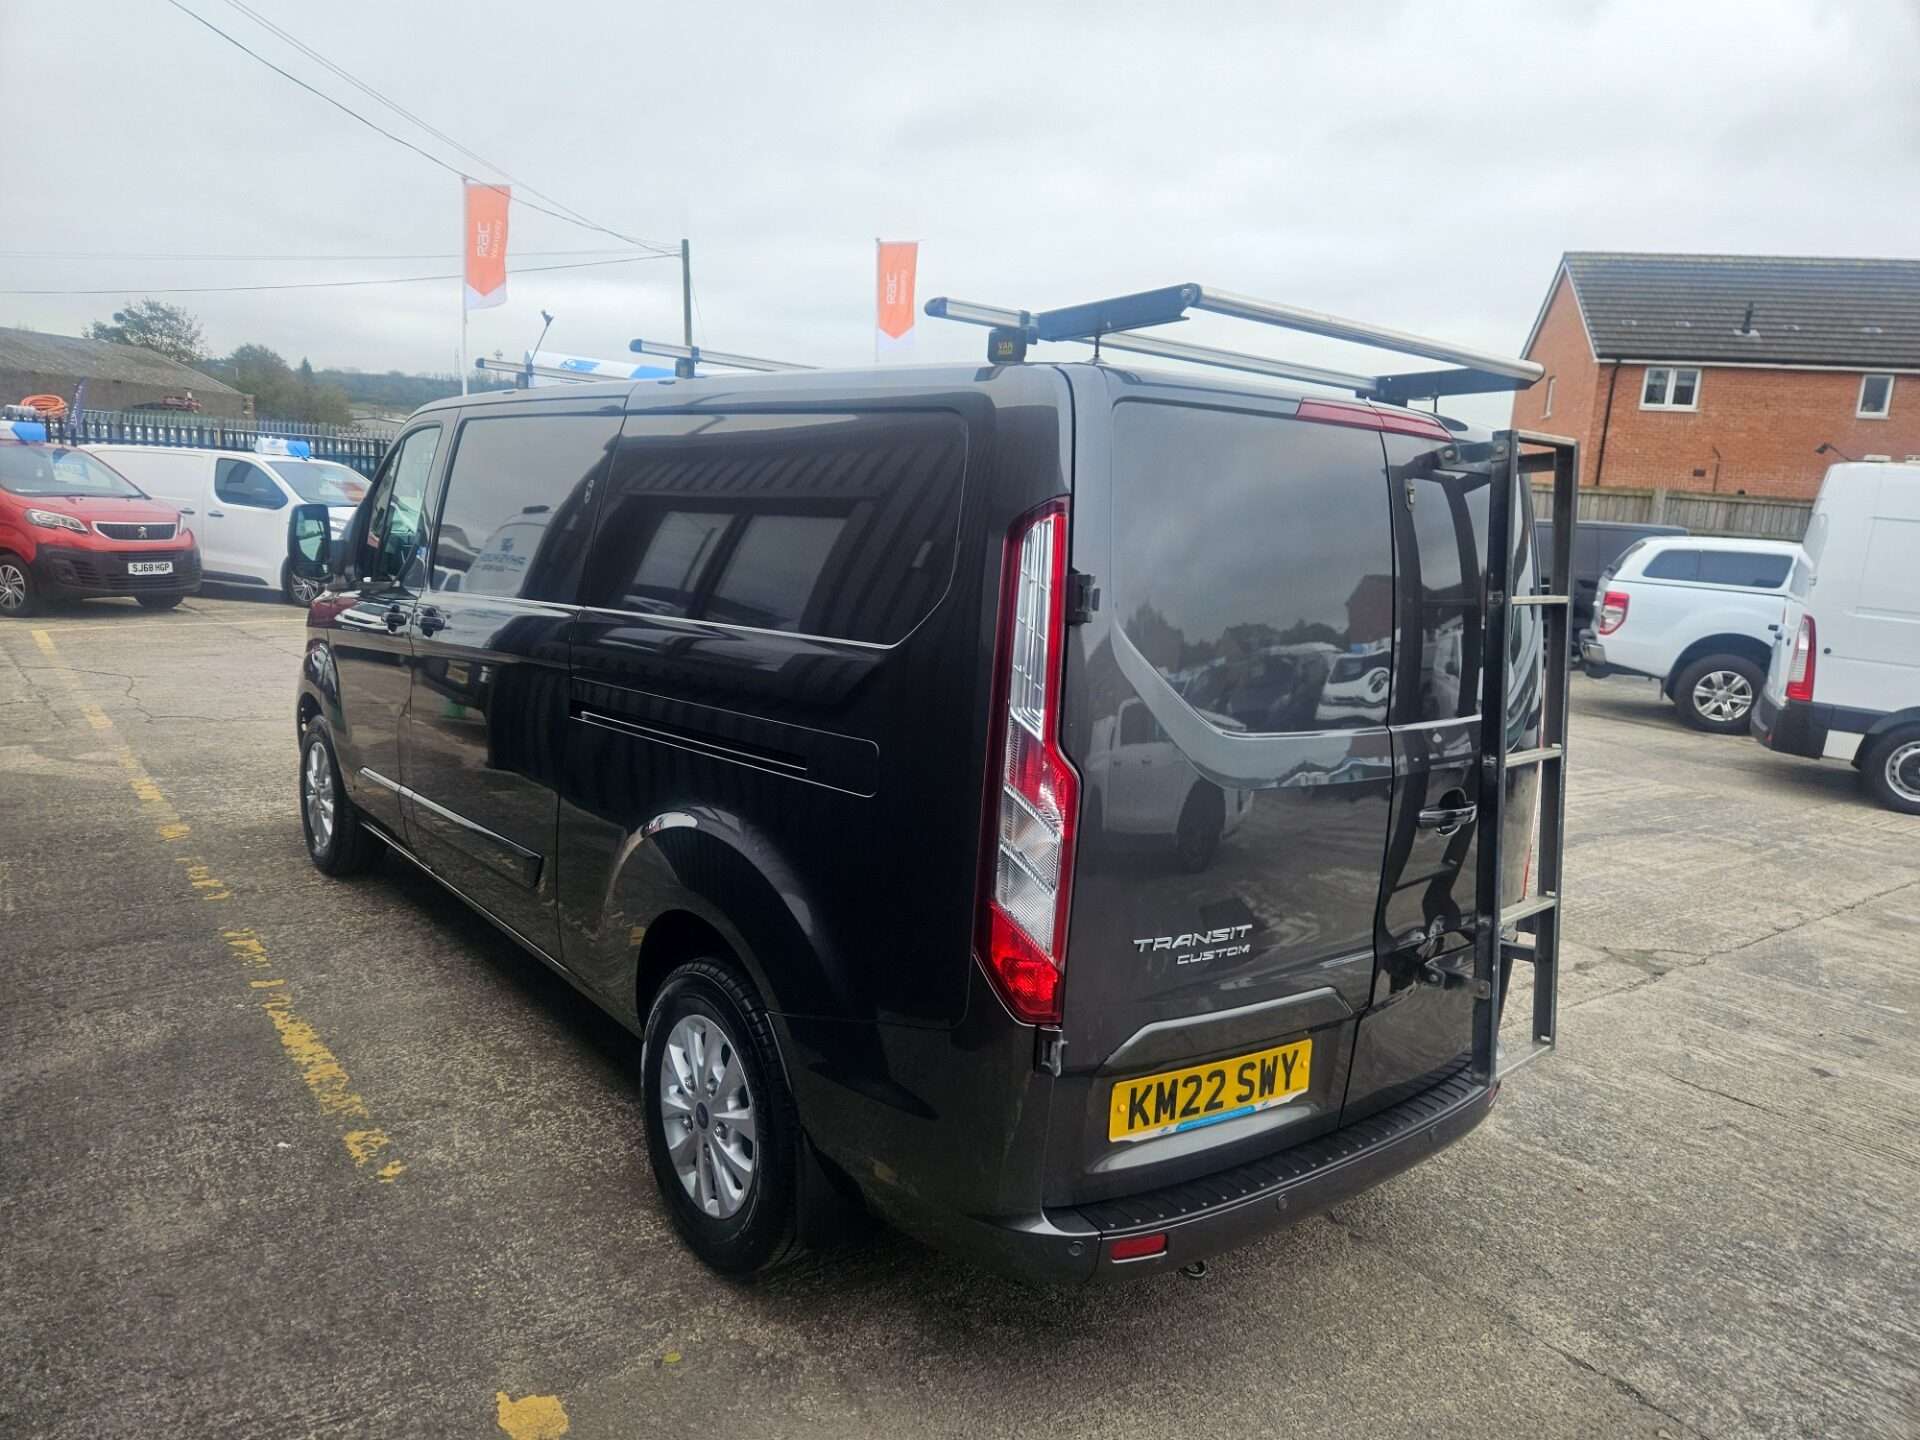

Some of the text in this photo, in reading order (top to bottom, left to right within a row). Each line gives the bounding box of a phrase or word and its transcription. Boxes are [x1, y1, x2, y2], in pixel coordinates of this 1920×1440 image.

[132, 562, 170, 573] SJ68 HGP
[1133, 923, 1253, 953] TRANSIT
[1176, 943, 1251, 965] CUSTOM
[1127, 1068, 1227, 1131] KM22
[1235, 1048, 1300, 1104] SWY
